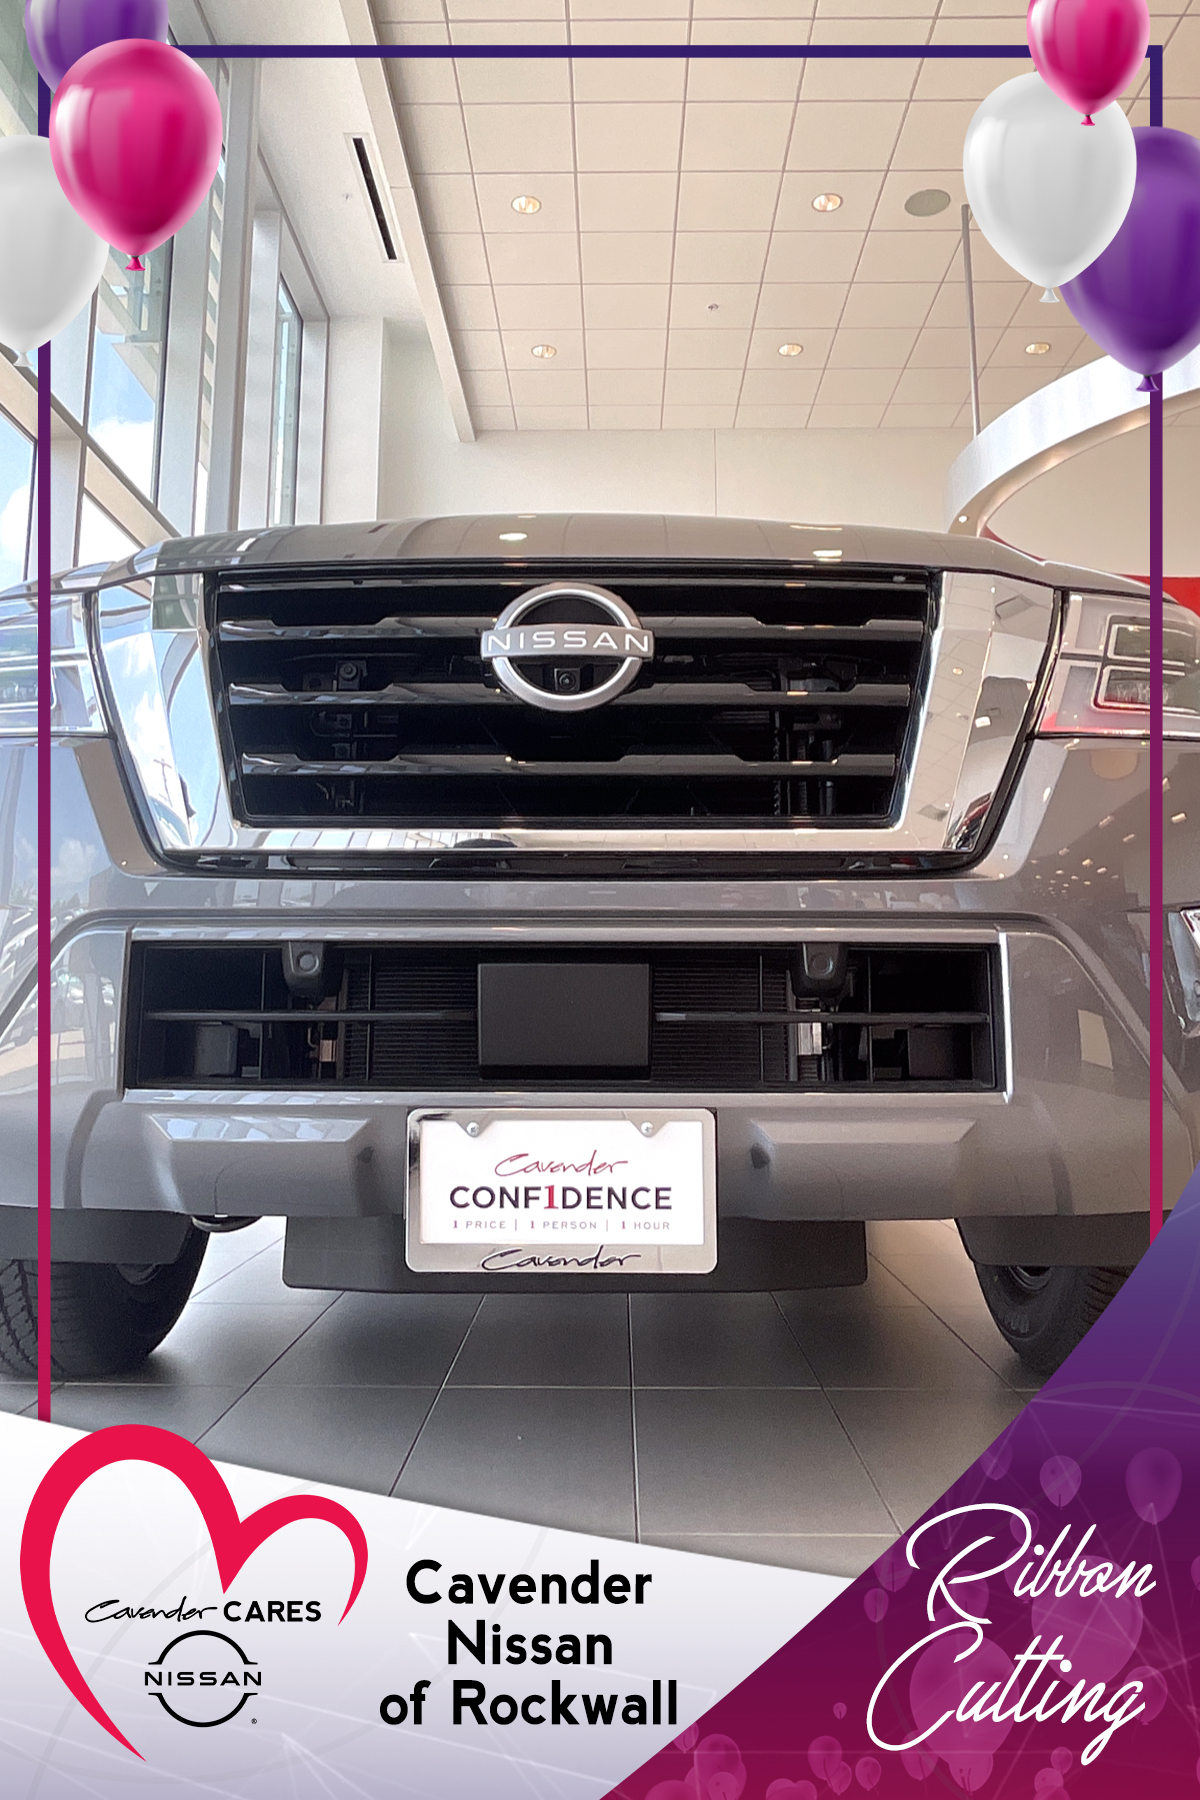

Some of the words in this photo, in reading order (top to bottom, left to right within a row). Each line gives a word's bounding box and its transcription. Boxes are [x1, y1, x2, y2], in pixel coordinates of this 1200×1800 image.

[487, 630, 649, 652] NISSAN
[494, 1149, 628, 1177] Cavender
[449, 1184, 672, 1210] CONF1DENCE
[453, 1219, 458, 1229] 1
[465, 1220, 506, 1229] PRICE
[530, 1219, 535, 1229] 1
[543, 1220, 597, 1229] PERSON
[621, 1220, 626, 1230] 1
[634, 1221, 670, 1230] HOUR
[481, 1244, 641, 1271] Cavender
